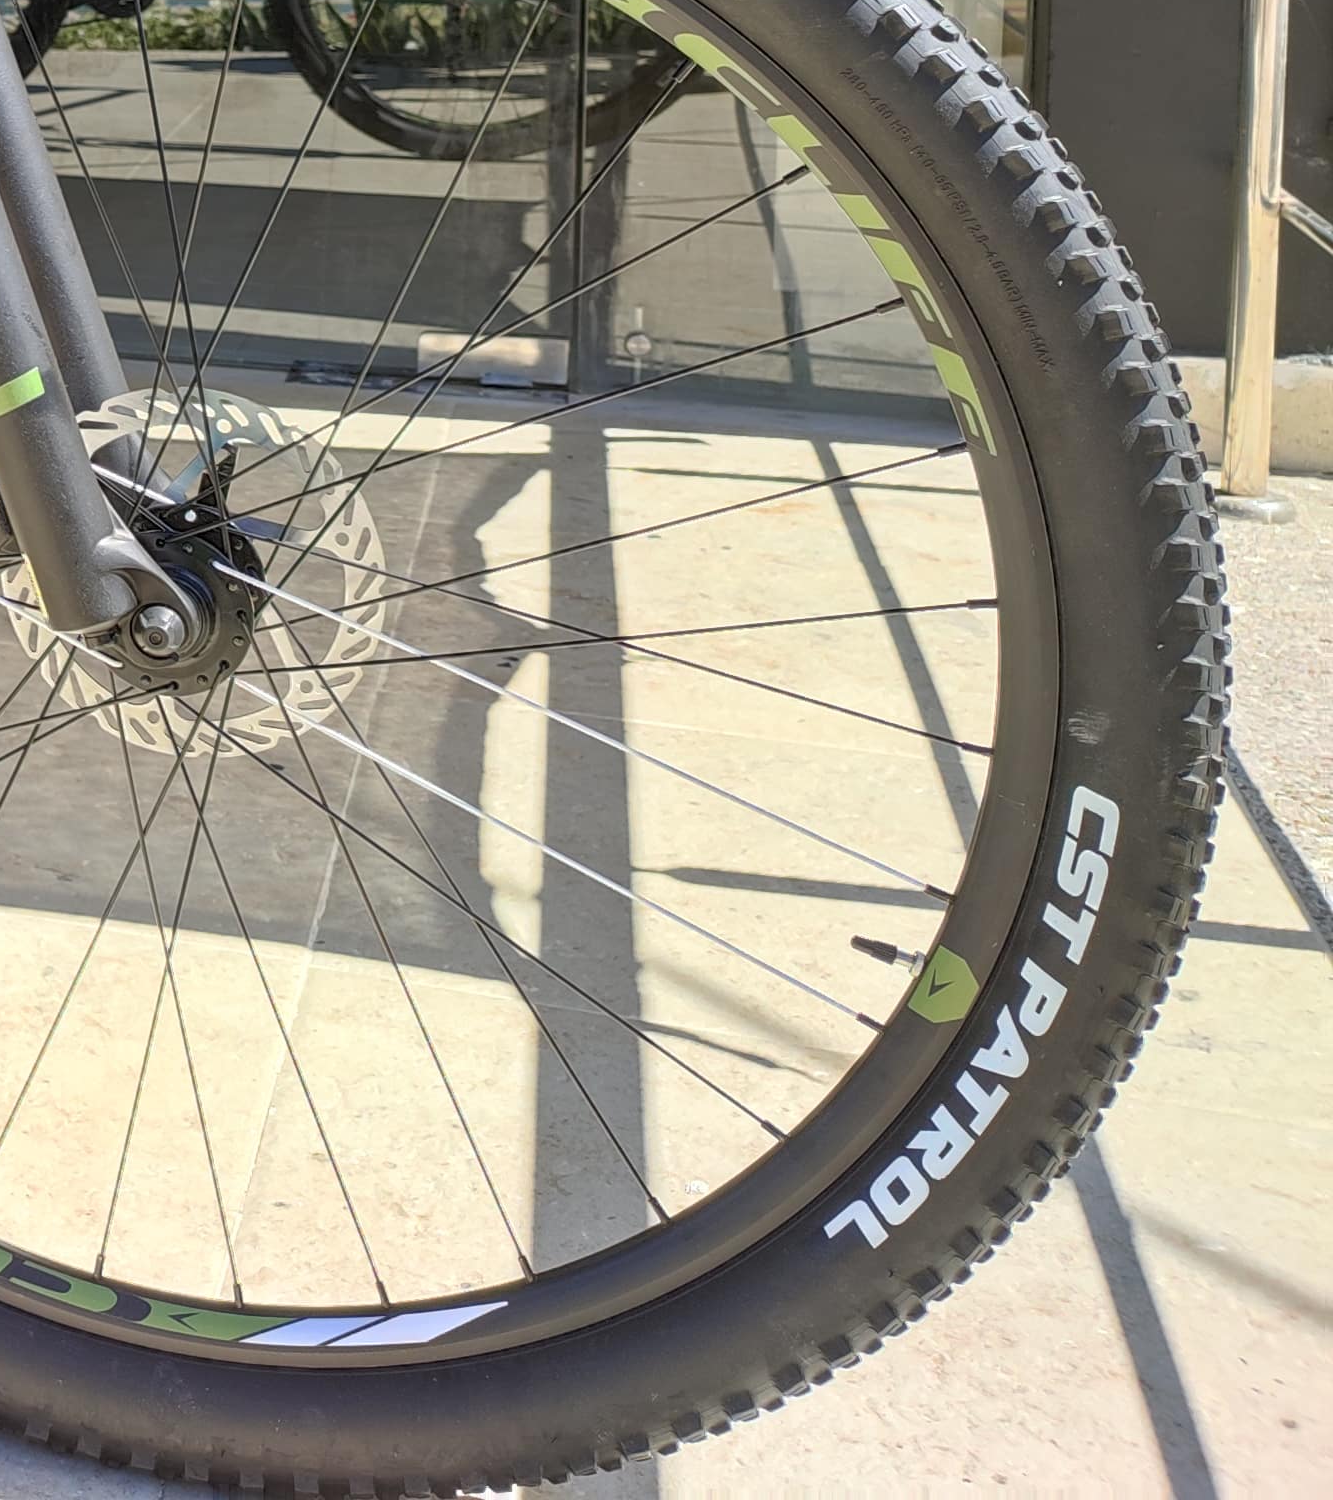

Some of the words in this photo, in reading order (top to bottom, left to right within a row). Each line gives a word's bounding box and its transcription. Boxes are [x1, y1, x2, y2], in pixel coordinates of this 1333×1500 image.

[673, 33, 997, 457] CLIFF
[1042, 785, 1121, 966] CST
[822, 957, 1068, 1249] PATROL
